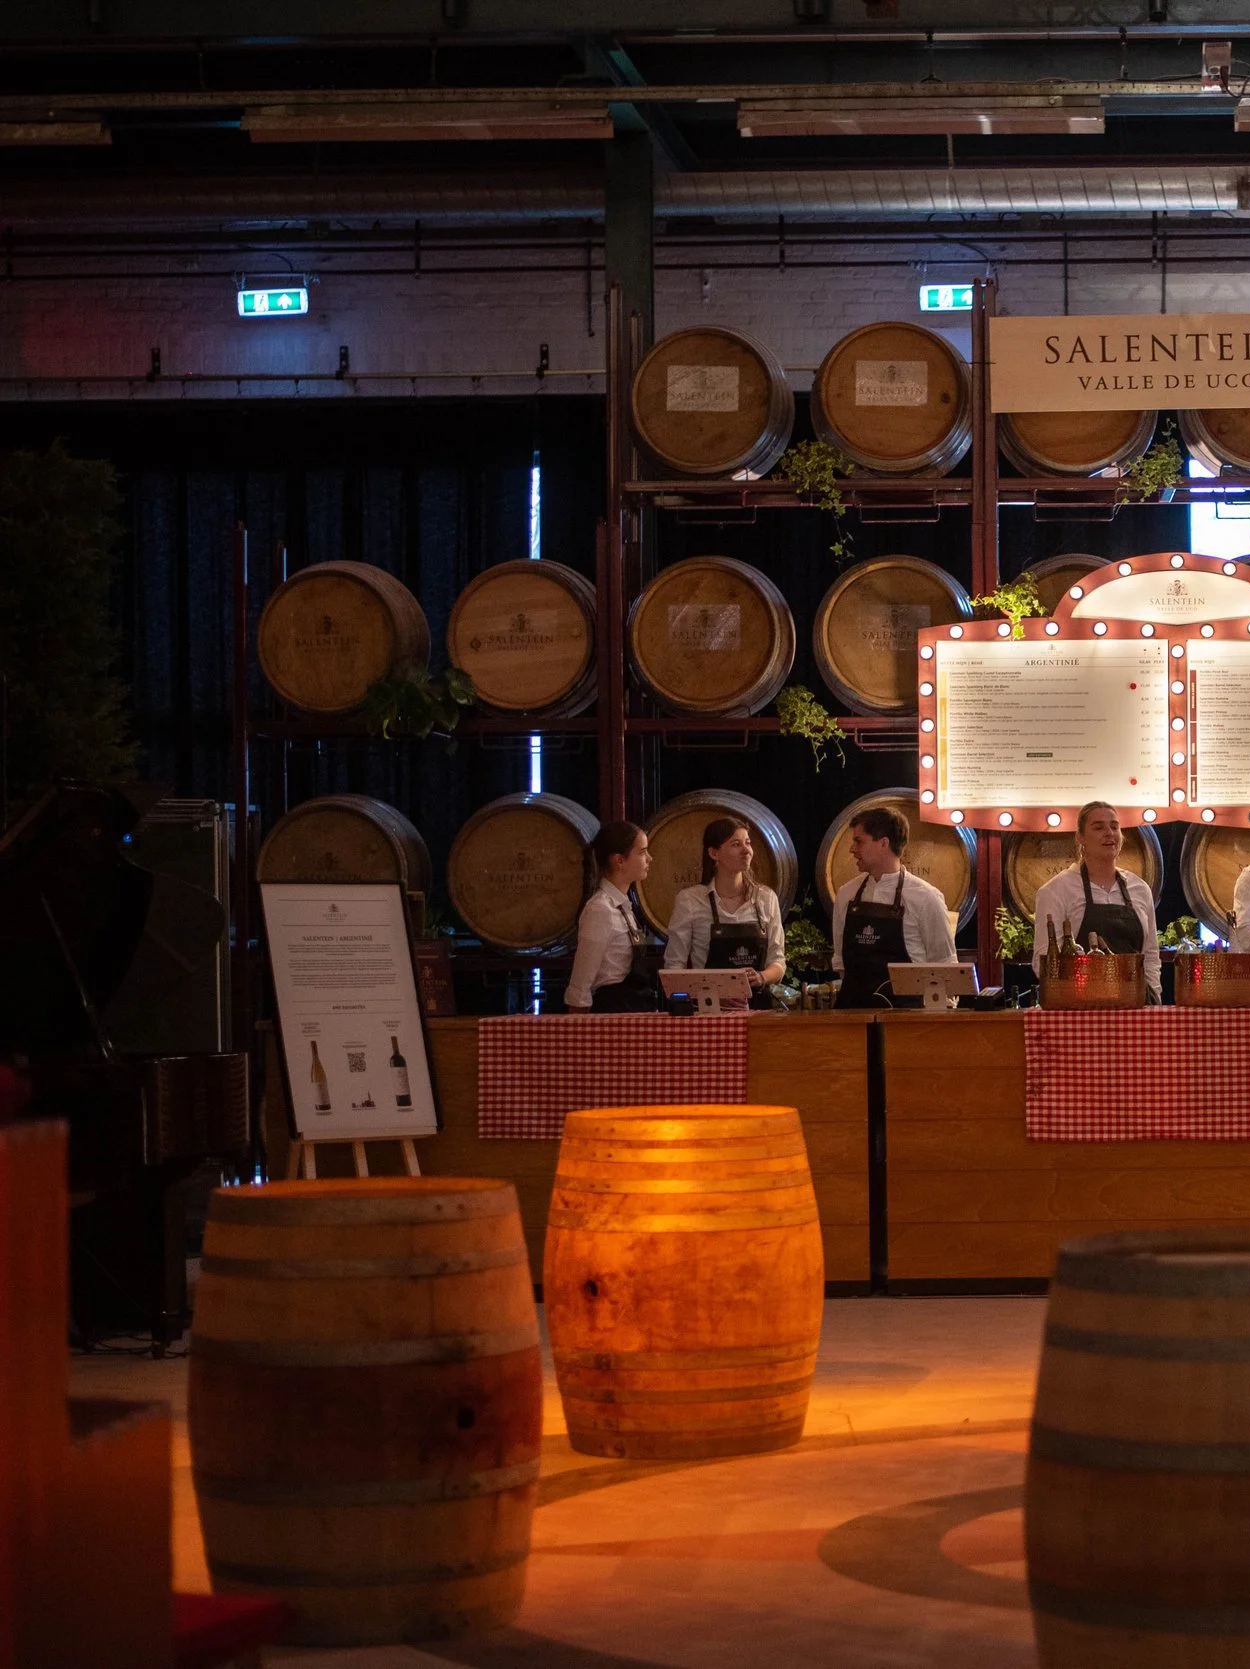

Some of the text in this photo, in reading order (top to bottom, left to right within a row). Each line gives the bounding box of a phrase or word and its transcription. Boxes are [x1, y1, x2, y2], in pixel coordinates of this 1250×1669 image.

[1078, 375, 1154, 391] VALLE
[1165, 374, 1196, 390] DE
[1149, 597, 1206, 606] SALENTEIN
[488, 634, 554, 645] SALENTEIN
